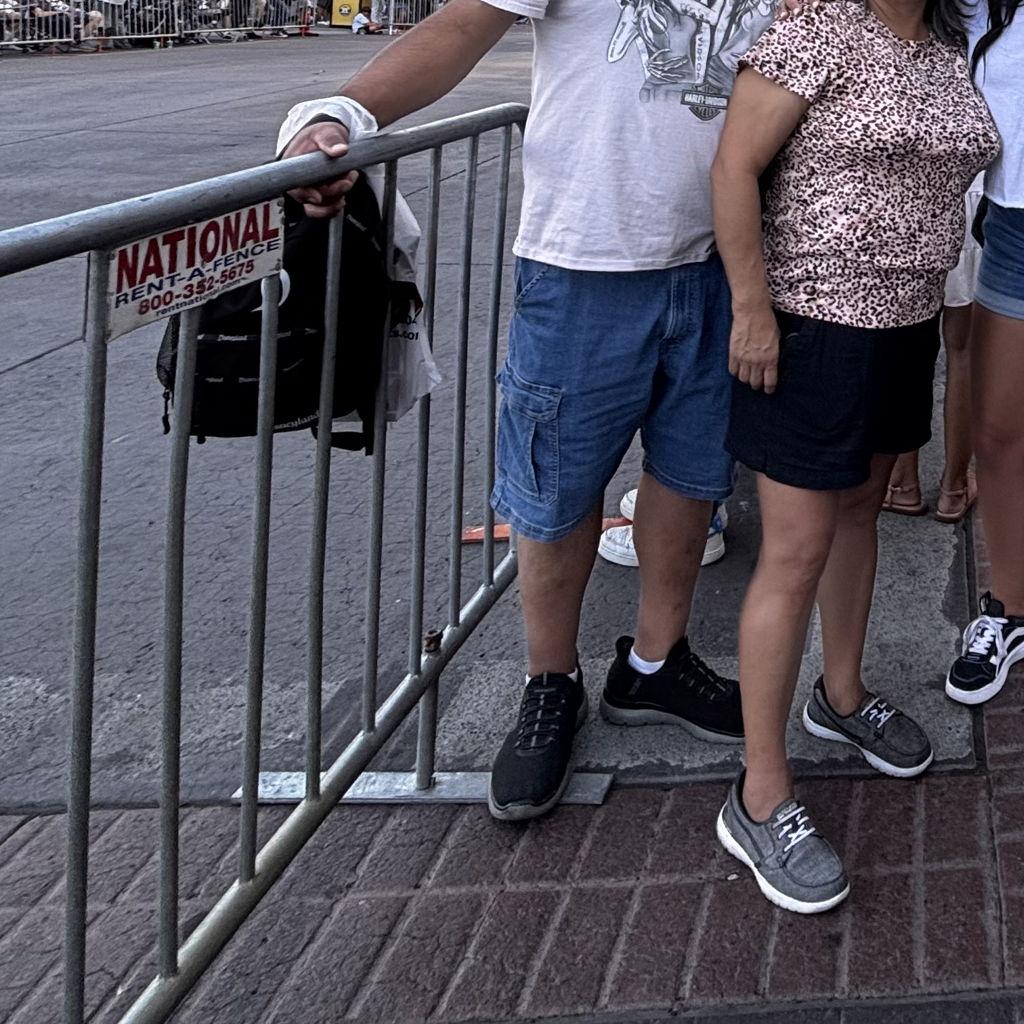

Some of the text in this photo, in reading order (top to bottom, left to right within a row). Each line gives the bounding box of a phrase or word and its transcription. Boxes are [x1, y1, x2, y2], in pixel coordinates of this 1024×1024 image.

[115, 203, 279, 294] NATIONAL
[115, 238, 281, 309] RENT-A-FENCE
[138, 259, 255, 315] 800-352-5675
